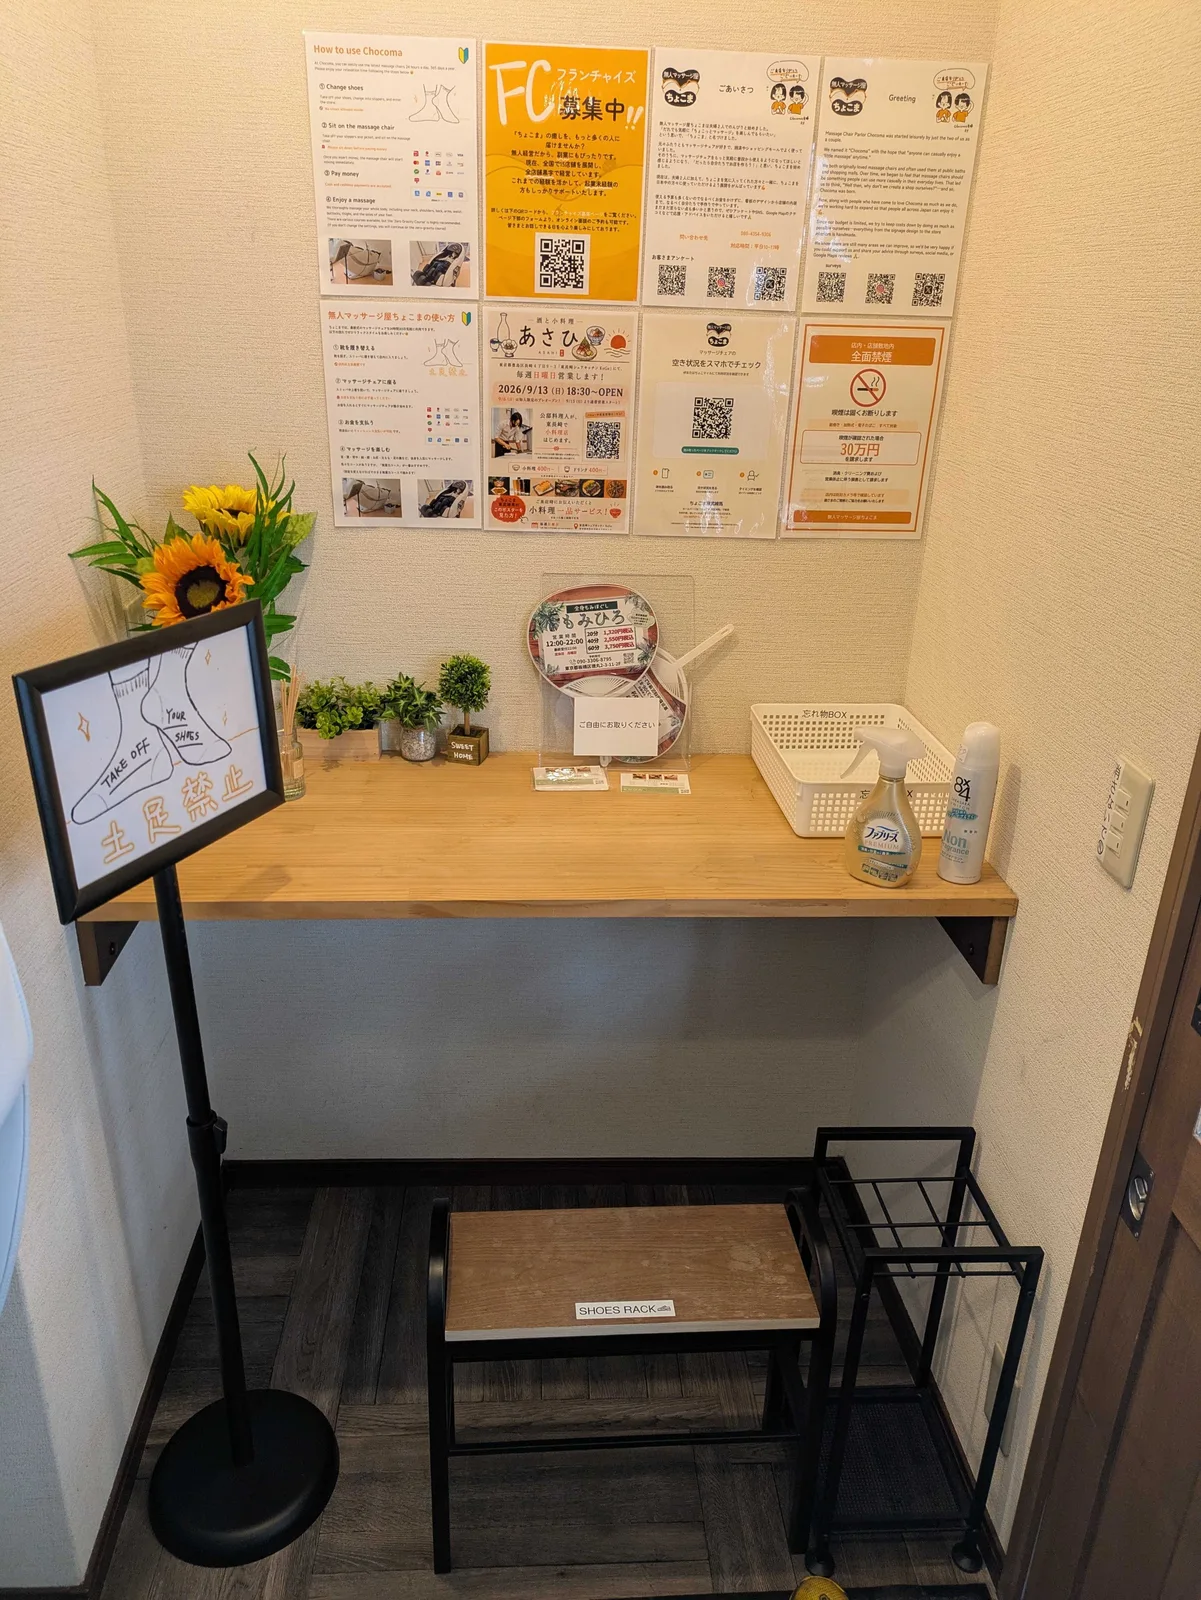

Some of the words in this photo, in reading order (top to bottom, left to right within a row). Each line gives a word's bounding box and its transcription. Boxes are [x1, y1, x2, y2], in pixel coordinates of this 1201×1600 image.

[313, 45, 333, 54] How
[335, 46, 344, 55] to
[346, 48, 361, 56] use
[363, 46, 403, 57] Chocoma
[557, 68, 636, 83] フランチャイズ
[489, 59, 555, 126] FC
[719, 85, 754, 94] ごあいさつ
[666, 93, 695, 103] ちょこま
[888, 94, 917, 104] Greeting
[833, 102, 861, 113] ちょこま
[328, 311, 456, 323] 無人マッサージ屋ちょこまの使い方
[519, 325, 578, 348] あさひ
[851, 351, 893, 363] 全面禁煙
[672, 359, 761, 369] 空き状況をスマホでチェック
[498, 384, 549, 395] 2026/9/13
[832, 409, 898, 417] 喫煙は固くお断りします
[840, 442, 880, 457] 30万円
[563, 610, 625, 630] もみひろ
[546, 639, 584, 647] 12:00-22:00
[166, 708, 188, 722] YOUR
[802, 709, 848, 719] 忘れ物BOX
[579, 721, 656, 730] ご自由にお取りください
[174, 730, 201, 742] SHOES
[451, 742, 474, 751] SWEET
[454, 752, 473, 760] HOME
[101, 760, 128, 789] TAKE
[130, 738, 151, 761] OFF
[102, 764, 254, 864] 土足禁止
[864, 825, 900, 843] ファブリーズ
[944, 829, 967, 849] Non
[864, 840, 900, 850] PREMIUM
[579, 1306, 621, 1316] SHOES
[624, 1304, 657, 1314] RACK
